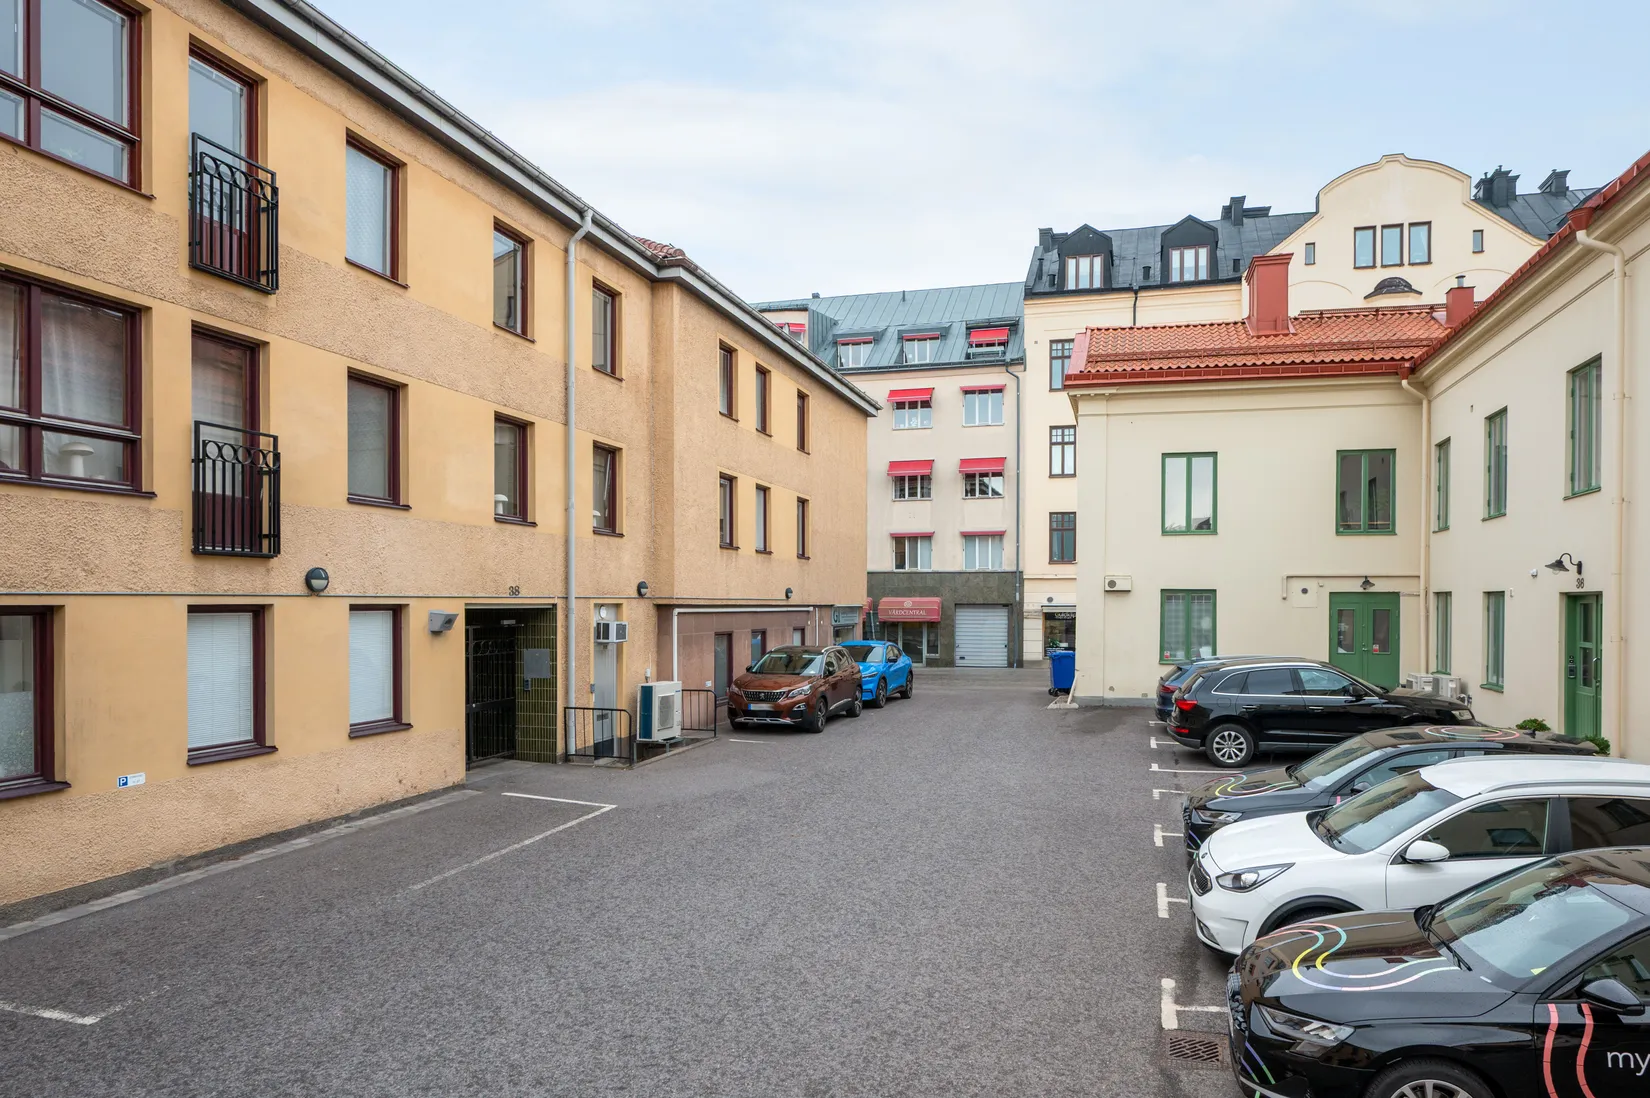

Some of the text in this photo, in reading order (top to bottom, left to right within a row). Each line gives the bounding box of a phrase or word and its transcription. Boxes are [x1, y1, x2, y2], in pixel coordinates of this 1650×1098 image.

[508, 585, 520, 596] 38
[120, 777, 127, 786] P
[1606, 1051, 1650, 1076] my
